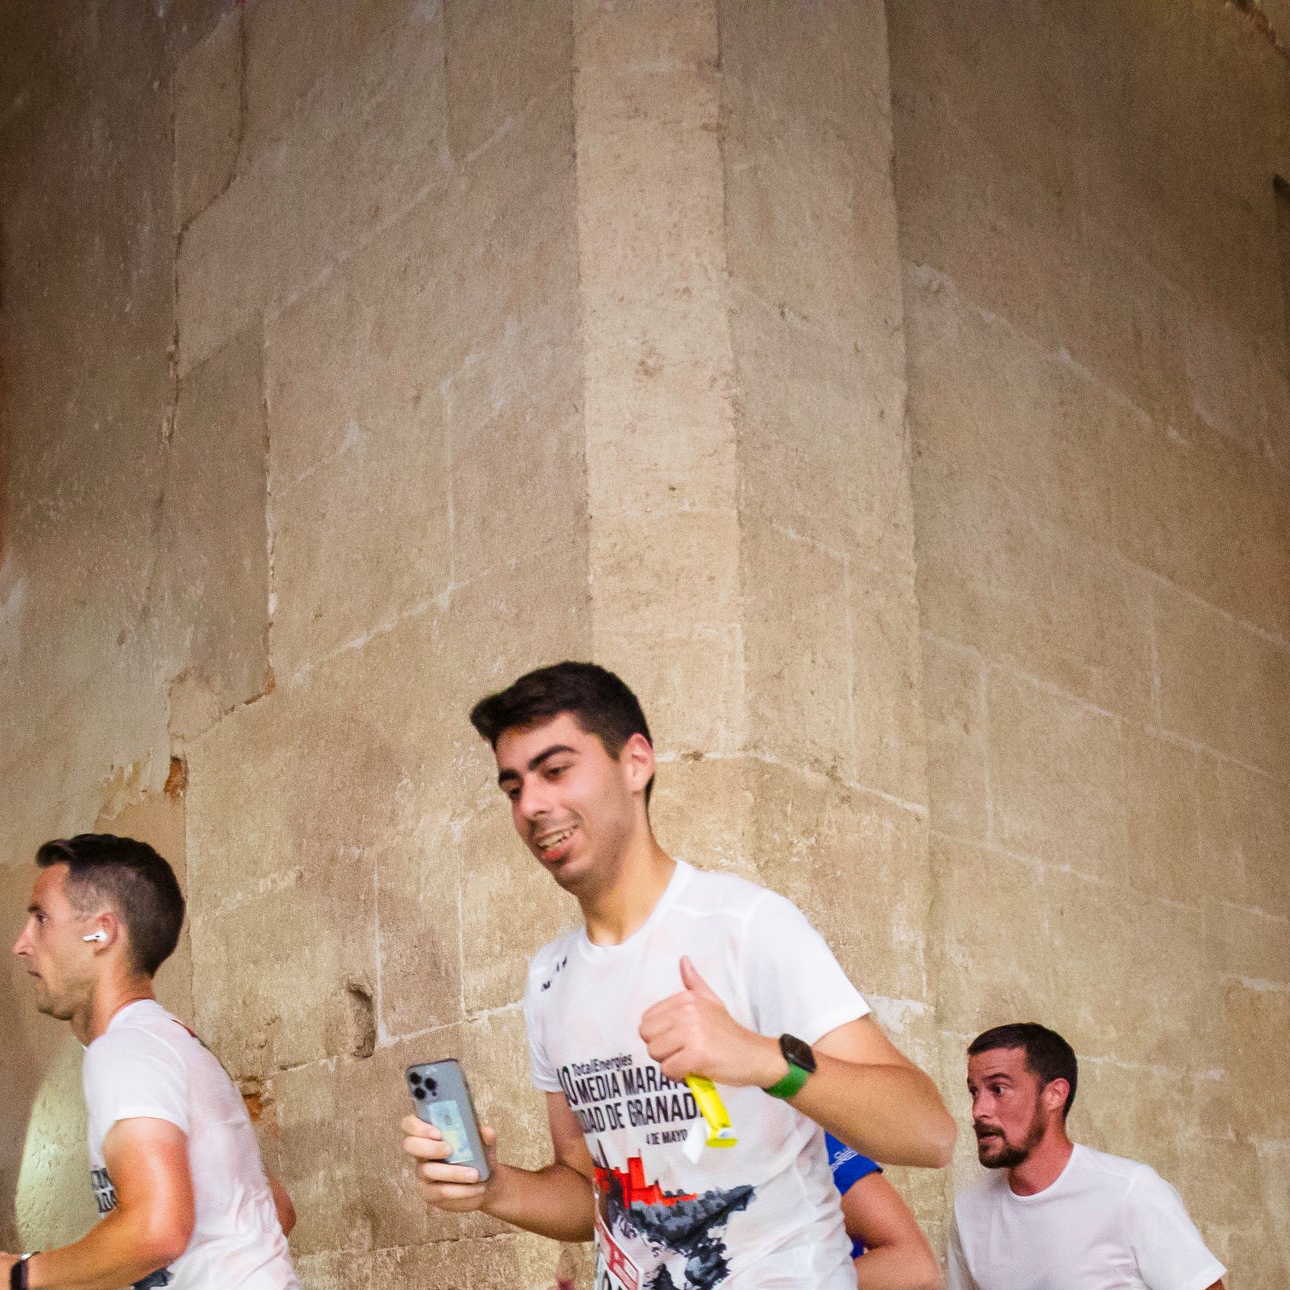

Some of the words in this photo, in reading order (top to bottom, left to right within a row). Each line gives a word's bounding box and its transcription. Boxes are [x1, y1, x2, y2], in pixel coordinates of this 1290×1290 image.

[571, 1052, 633, 1077] TotalEnergies
[574, 1071, 622, 1105] MEDIA
[623, 1065, 689, 1096] MARA
[576, 1107, 606, 1135] DAD
[605, 1102, 626, 1131] DE
[626, 1091, 703, 1128] GRANAD
